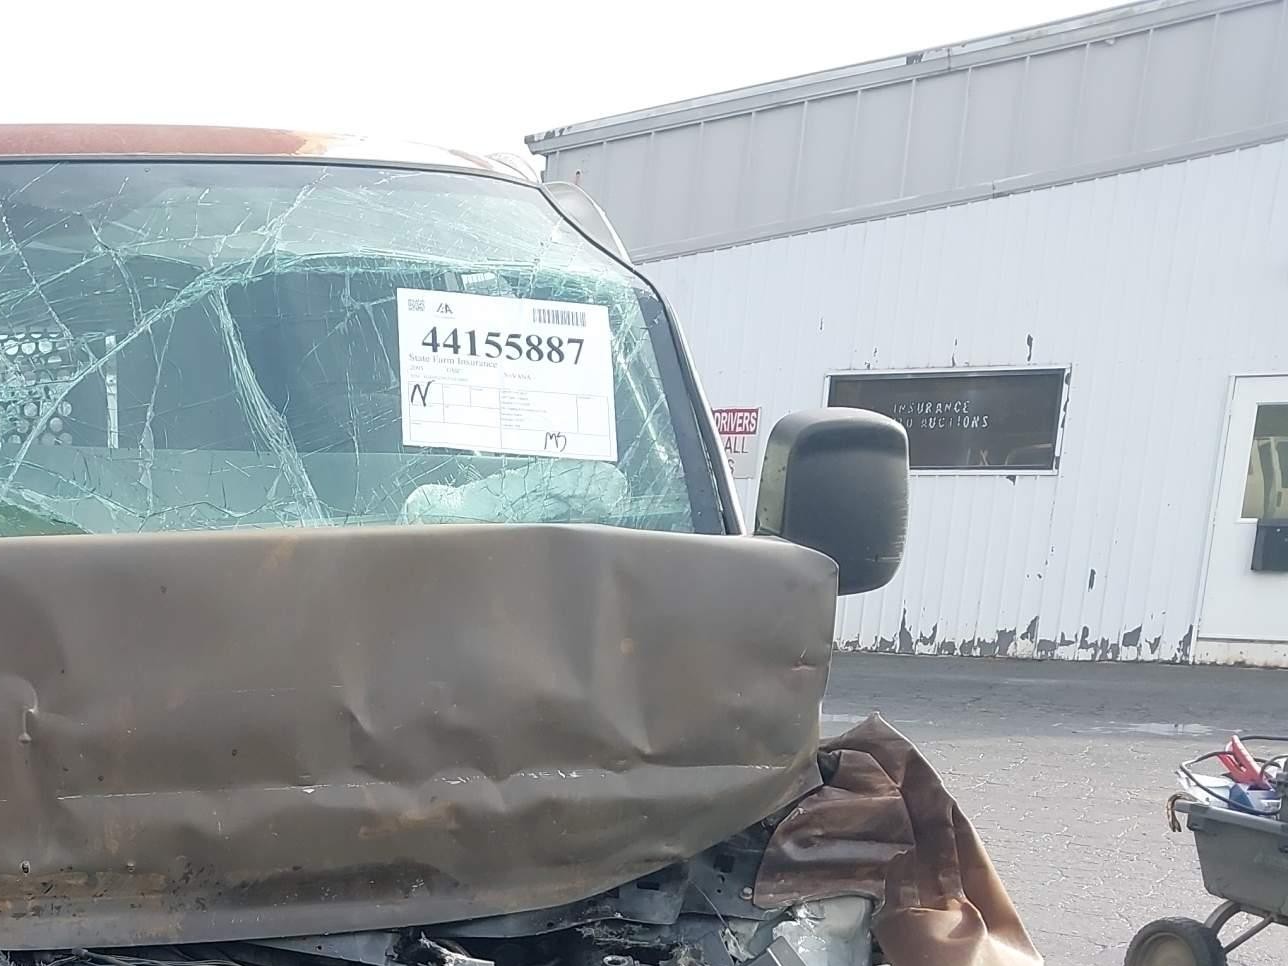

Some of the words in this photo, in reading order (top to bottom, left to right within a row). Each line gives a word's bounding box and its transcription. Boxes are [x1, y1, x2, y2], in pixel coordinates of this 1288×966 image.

[422, 326, 584, 365] 44155887
[409, 352, 431, 362] State
[433, 354, 455, 365] Farm
[457, 357, 499, 369] Insurance
[893, 400, 970, 414] INSURANCE
[714, 412, 757, 432] DRIVERS
